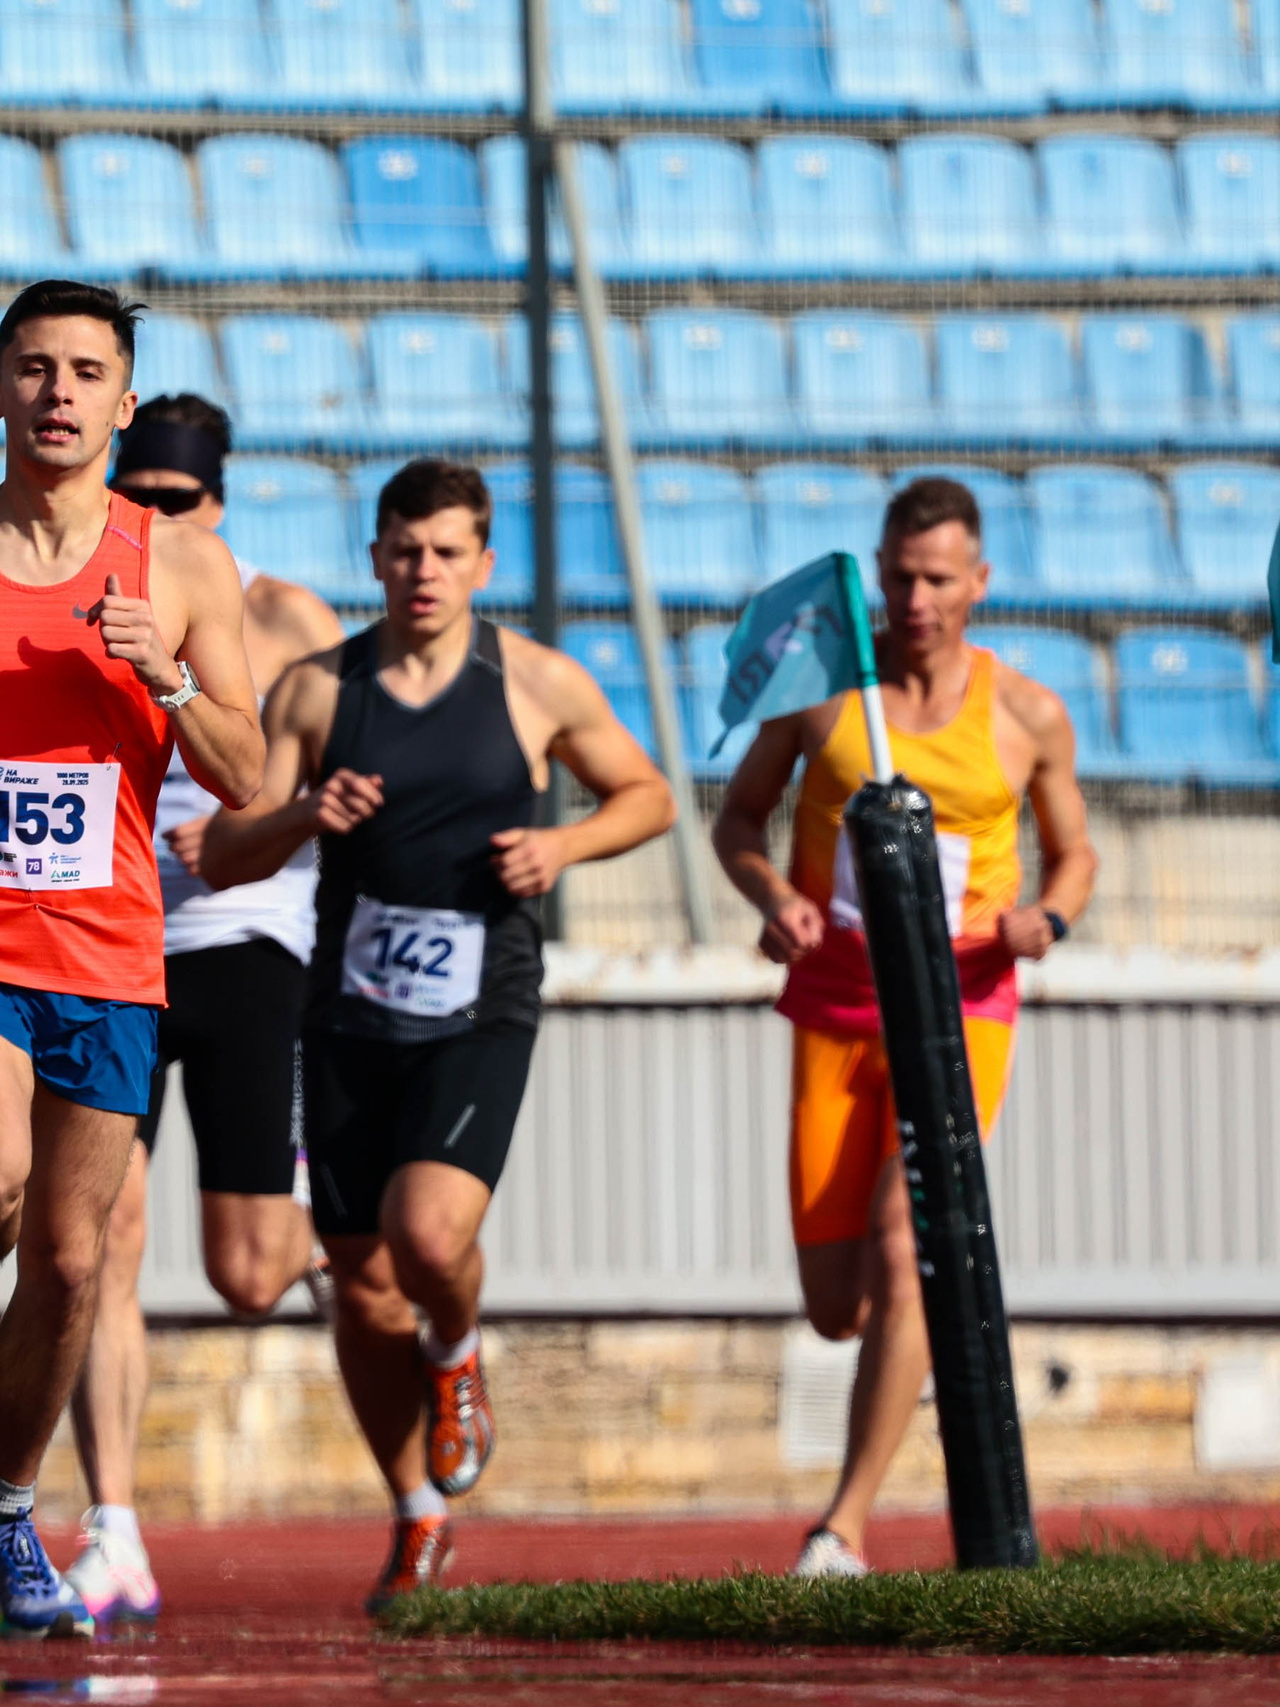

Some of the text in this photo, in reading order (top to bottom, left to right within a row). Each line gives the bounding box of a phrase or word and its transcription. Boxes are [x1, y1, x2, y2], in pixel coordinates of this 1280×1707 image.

[4, 776, 39, 785] ВИРАЖЕ
[28, 861, 40, 872] 78
[61, 870, 80, 878] MAD
[372, 928, 453, 977] 142
